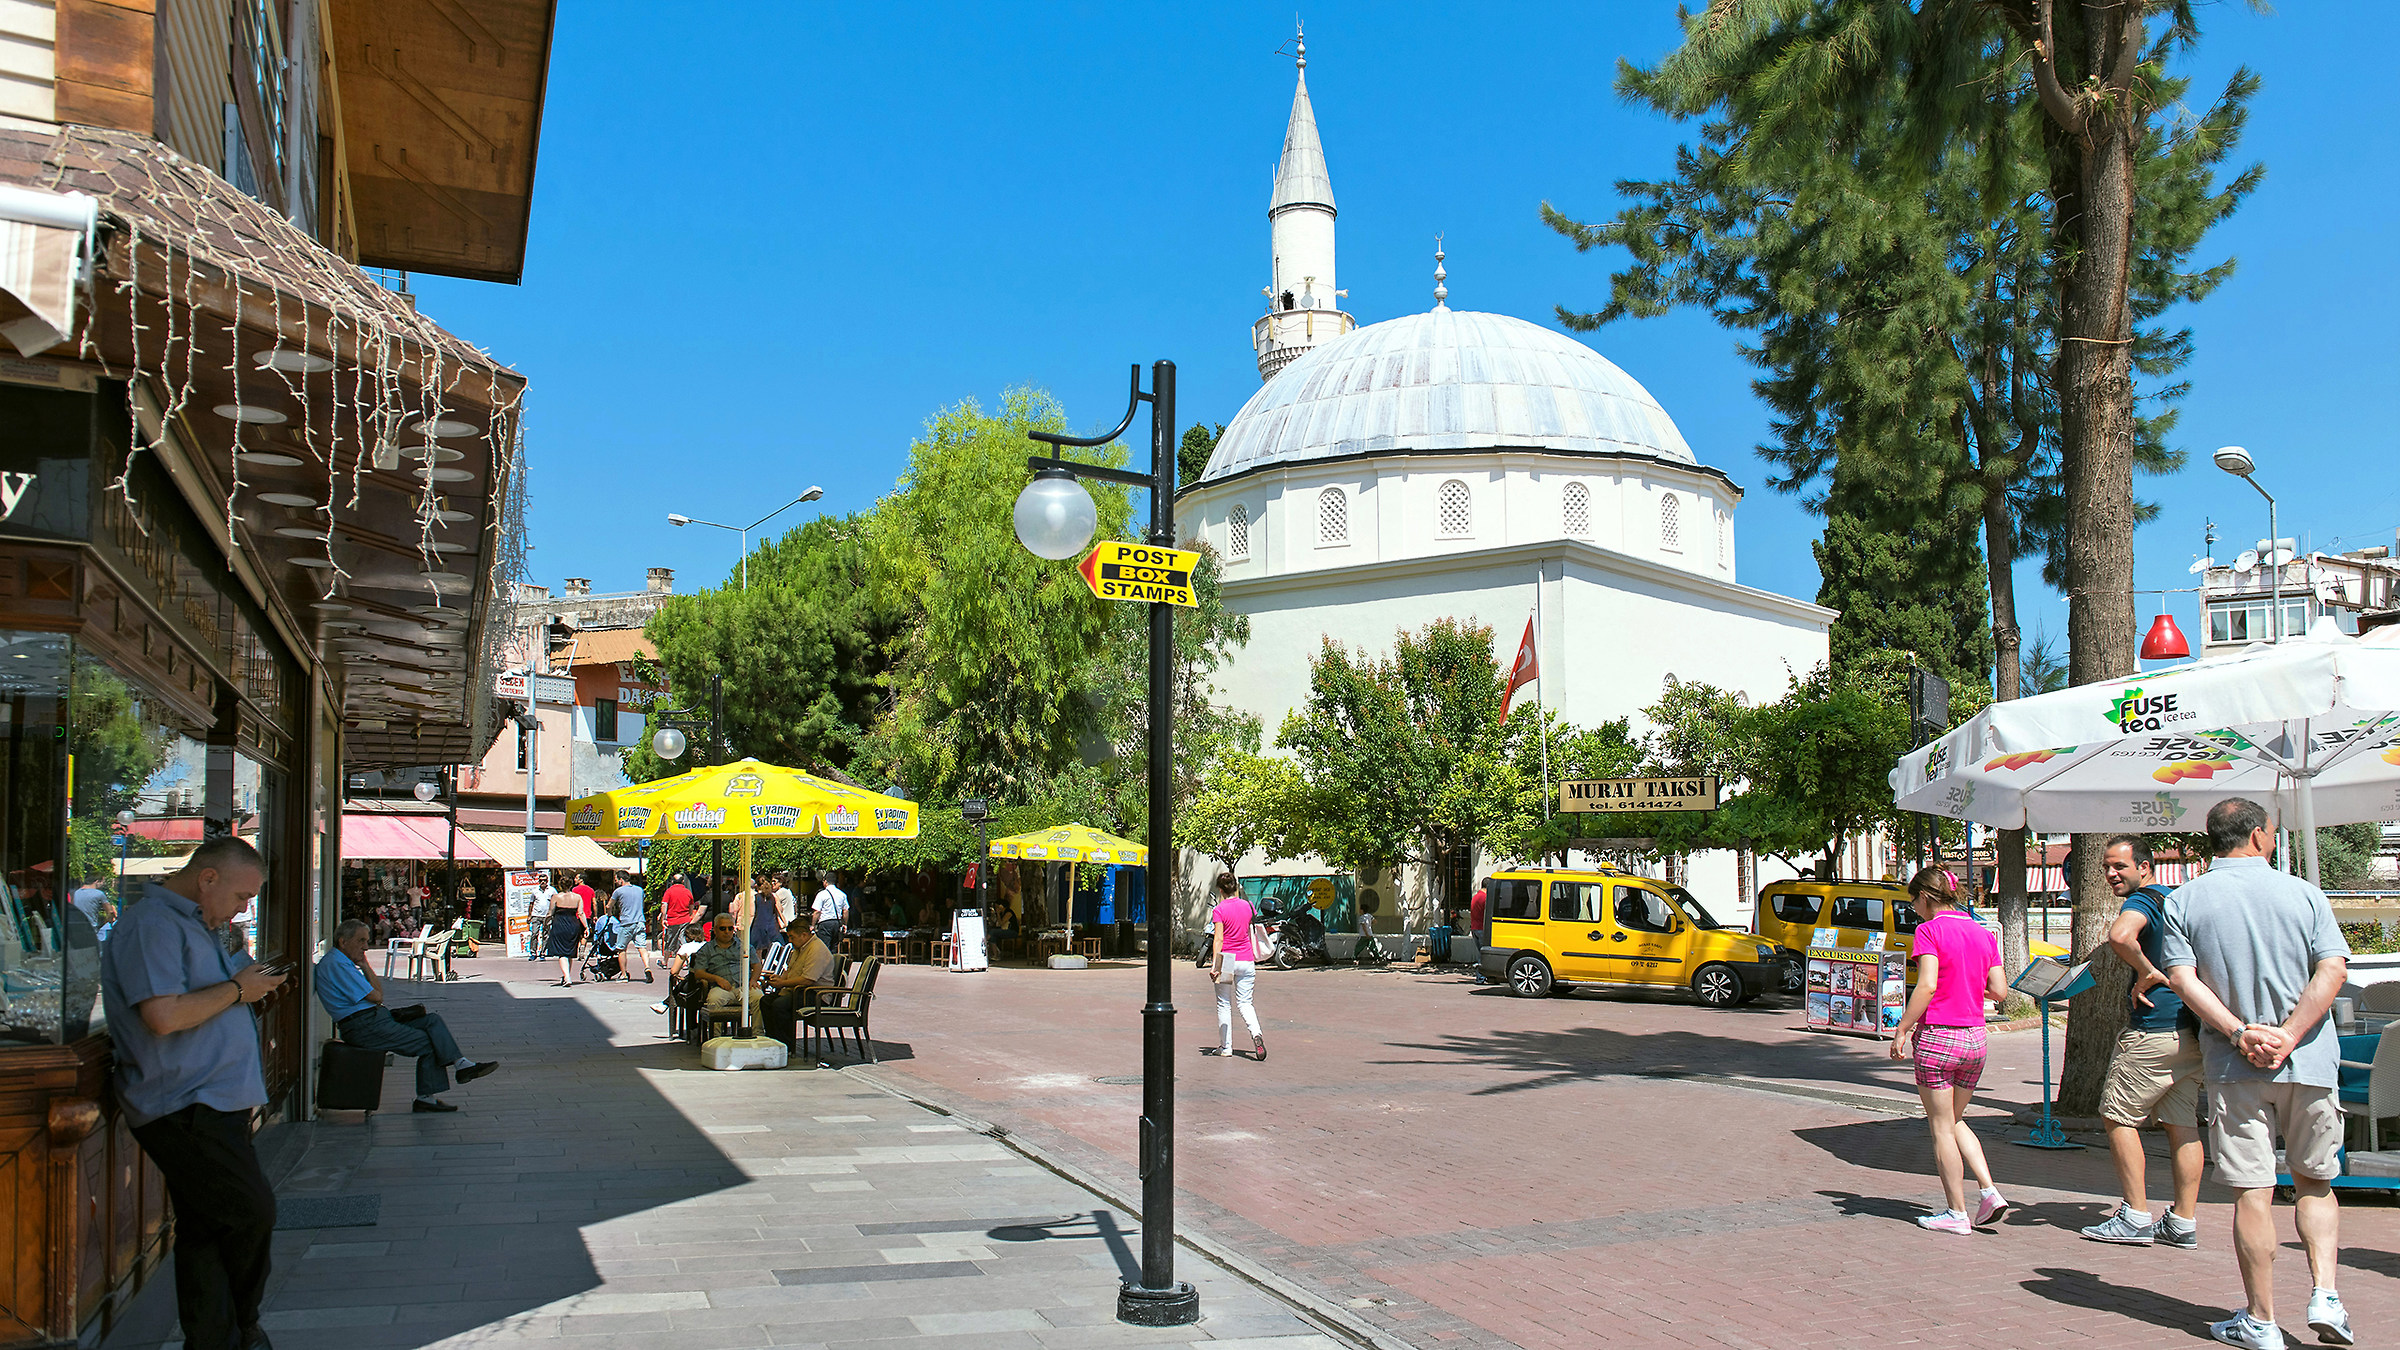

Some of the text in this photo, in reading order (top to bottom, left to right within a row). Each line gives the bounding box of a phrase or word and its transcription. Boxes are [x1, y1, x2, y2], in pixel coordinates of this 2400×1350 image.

[1117, 547, 1178, 566] POST
[1119, 566, 1170, 584] BOX
[1102, 582, 1188, 603] STAMPS
[2120, 694, 2178, 719] FUSE
[2118, 716, 2161, 734] tea
[2180, 711, 2197, 720] tea
[1568, 778, 1707, 799] MURAT TAKSİ
[618, 806, 627, 818] Ev
[750, 805, 763, 817] Ev
[874, 808, 884, 819] Ev
[1589, 801, 1684, 810] tel. 6141474
[675, 807, 726, 823] uludağ
[826, 809, 859, 826] uludağ
[1807, 949, 1878, 963] EXCURSIONS
